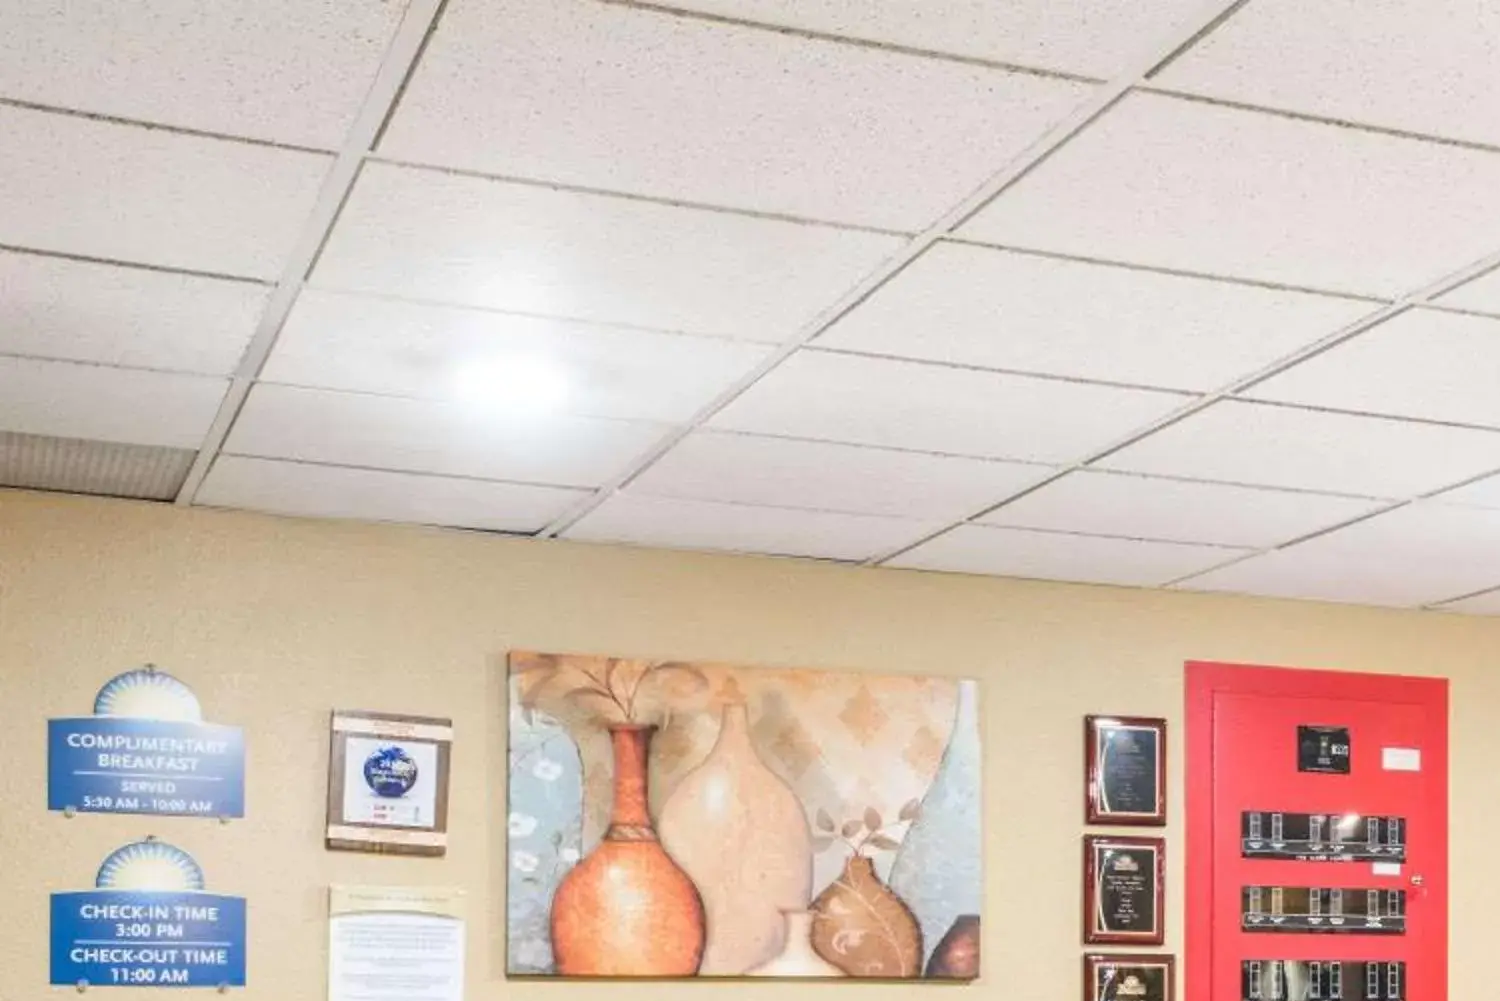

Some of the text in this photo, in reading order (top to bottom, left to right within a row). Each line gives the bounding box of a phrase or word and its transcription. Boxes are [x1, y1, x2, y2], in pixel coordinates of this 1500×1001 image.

[67, 733, 229, 754] COMPLIMENTARY
[98, 753, 200, 772] BREAKFAST
[120, 780, 176, 793] SERVED
[83, 796, 112, 808] 5:30
[115, 797, 139, 809] AM
[152, 800, 187, 811] 10:00
[189, 801, 213, 812] AM
[80, 904, 221, 922] CHECK-IN TIME
[115, 923, 183, 937] 3:00 PM
[70, 948, 228, 965] CHECK-OUT TIME
[110, 968, 189, 983] 11:00 AM
